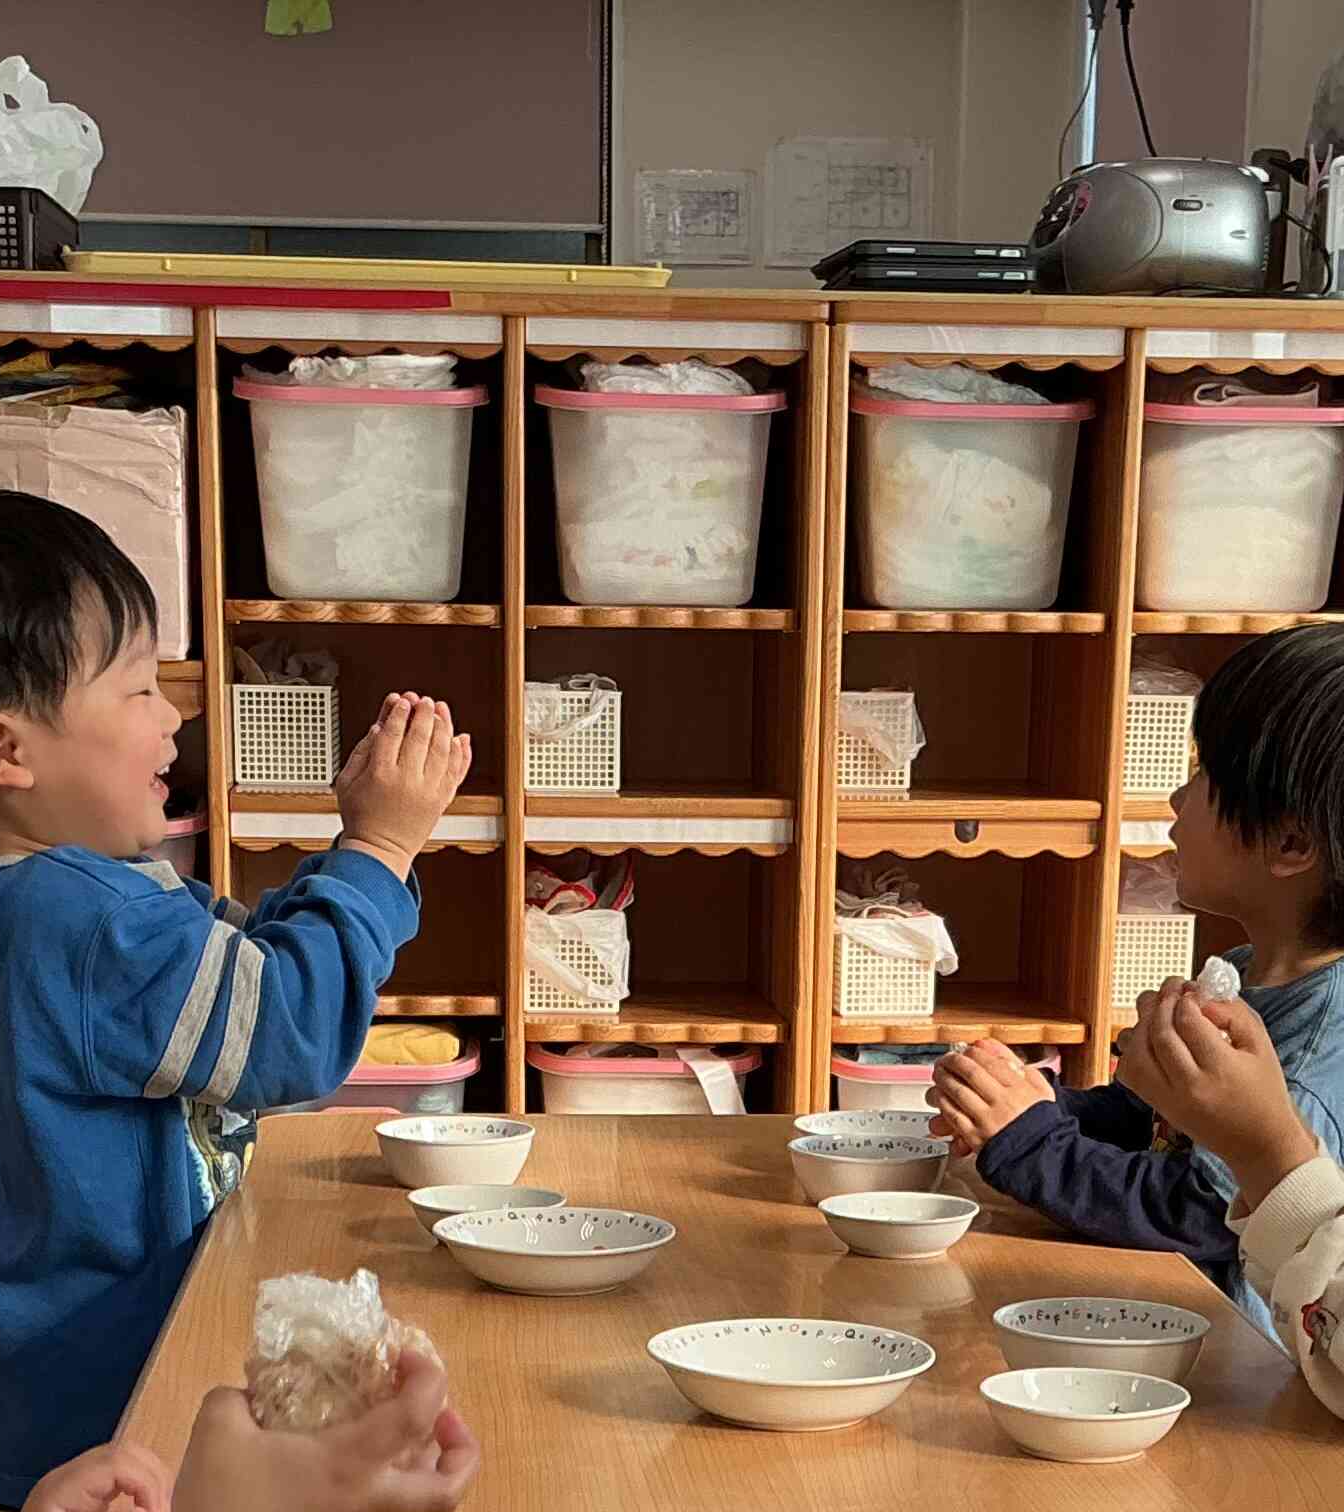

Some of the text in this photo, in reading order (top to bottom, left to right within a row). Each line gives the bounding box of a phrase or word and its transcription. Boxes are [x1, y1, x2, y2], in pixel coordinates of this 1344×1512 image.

[508, 1212, 518, 1220] Q
[1036, 1309, 1043, 1320] E
[845, 1328, 855, 1339] Q
